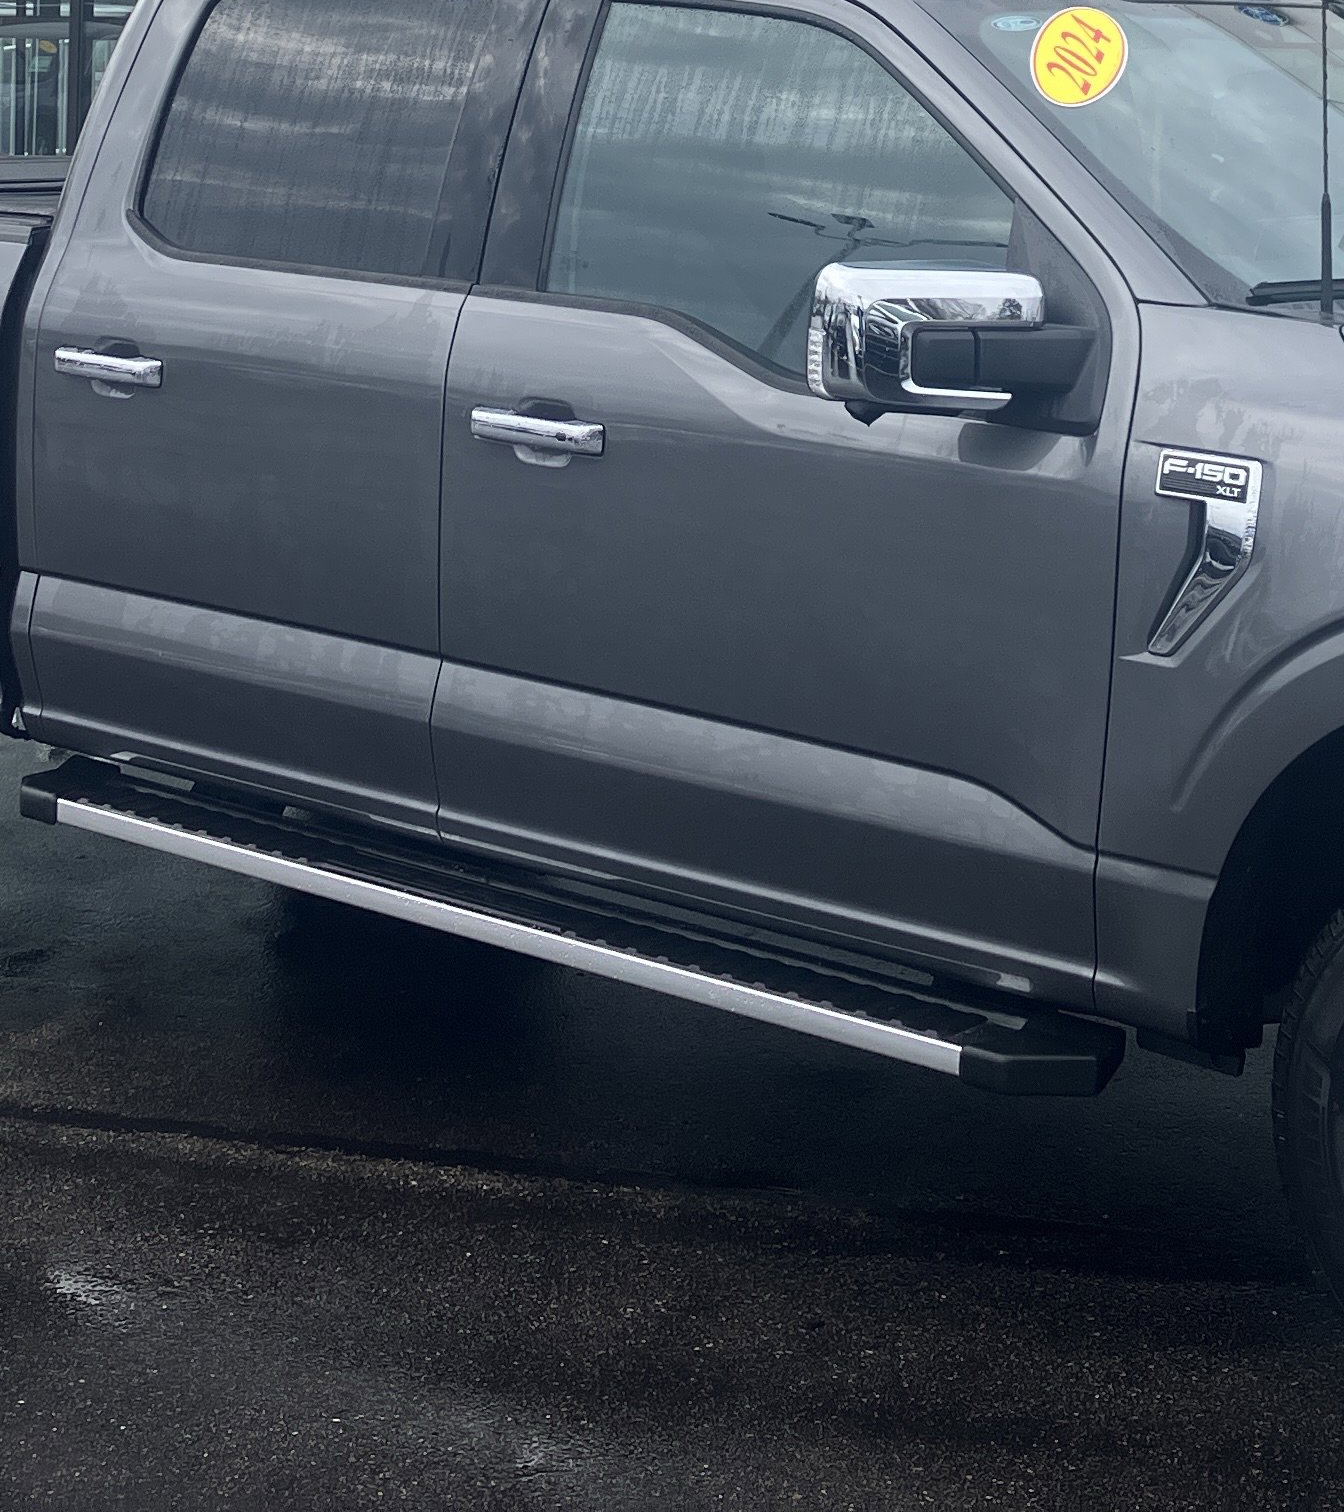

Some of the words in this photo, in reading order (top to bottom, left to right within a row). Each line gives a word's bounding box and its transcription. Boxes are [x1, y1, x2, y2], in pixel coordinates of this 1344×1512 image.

[1046, 13, 1111, 96] 2024
[1162, 457, 1248, 486] F-150
[1215, 484, 1242, 498] XLT
